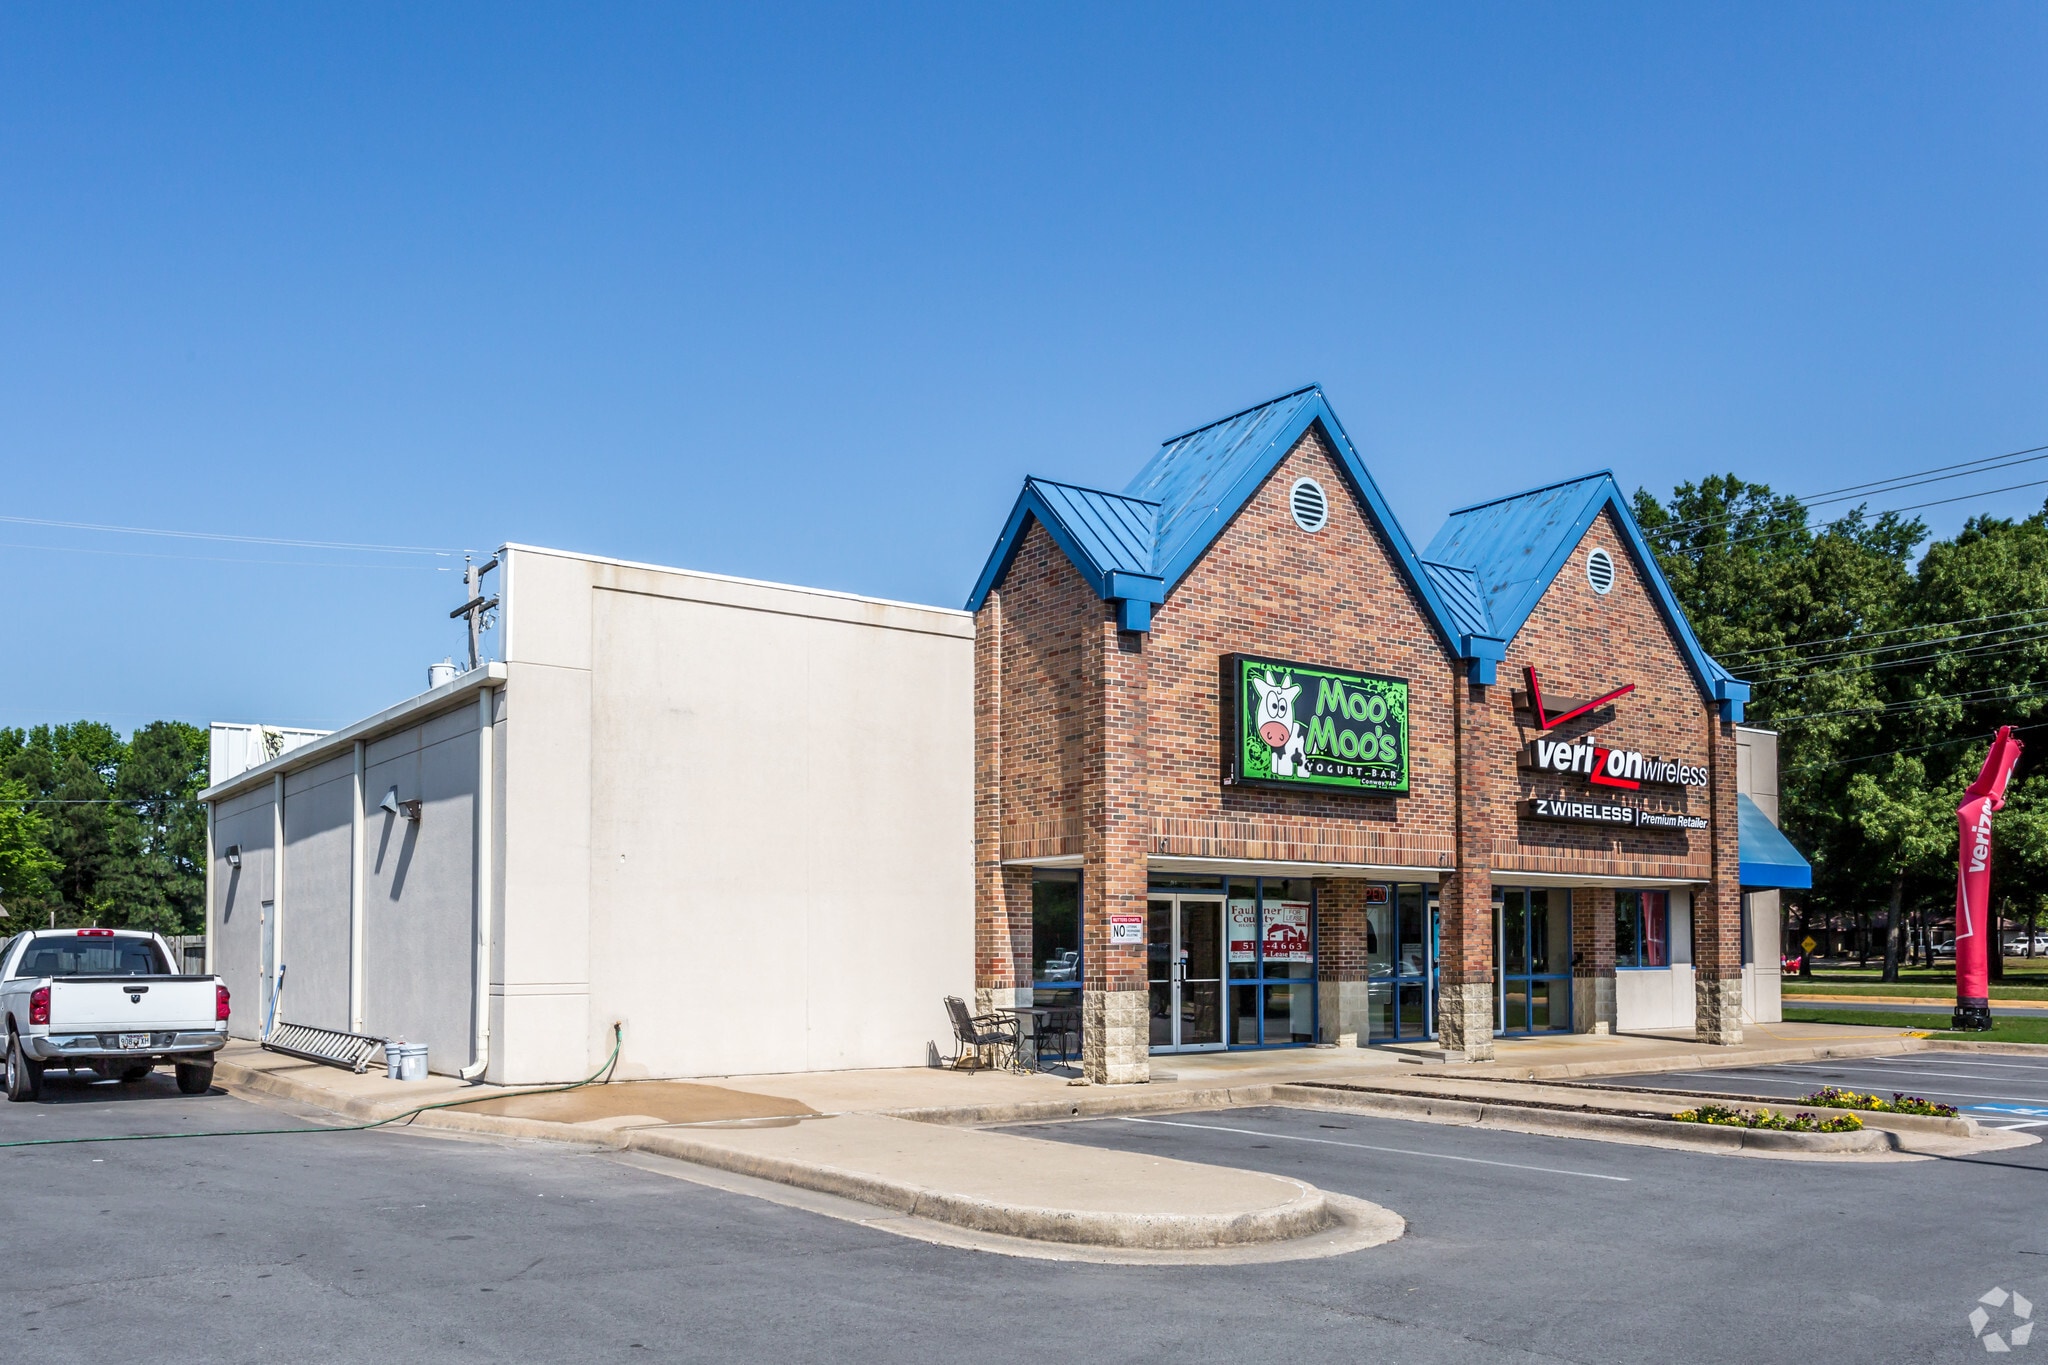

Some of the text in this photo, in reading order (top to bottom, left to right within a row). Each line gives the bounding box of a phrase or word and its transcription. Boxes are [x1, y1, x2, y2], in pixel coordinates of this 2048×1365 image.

[1316, 678, 1387, 724] Moo
[1305, 715, 1397, 762] Moo's
[1307, 762, 1396, 779] YOGURT BAR
[1537, 800, 1708, 830] Z WIRELESS Premium Retailer
[1968, 797, 1993, 873] verizo
[1231, 905, 1282, 915] Faulner
[1233, 914, 1275, 925] Couty
[1113, 925, 1125, 937] NO
